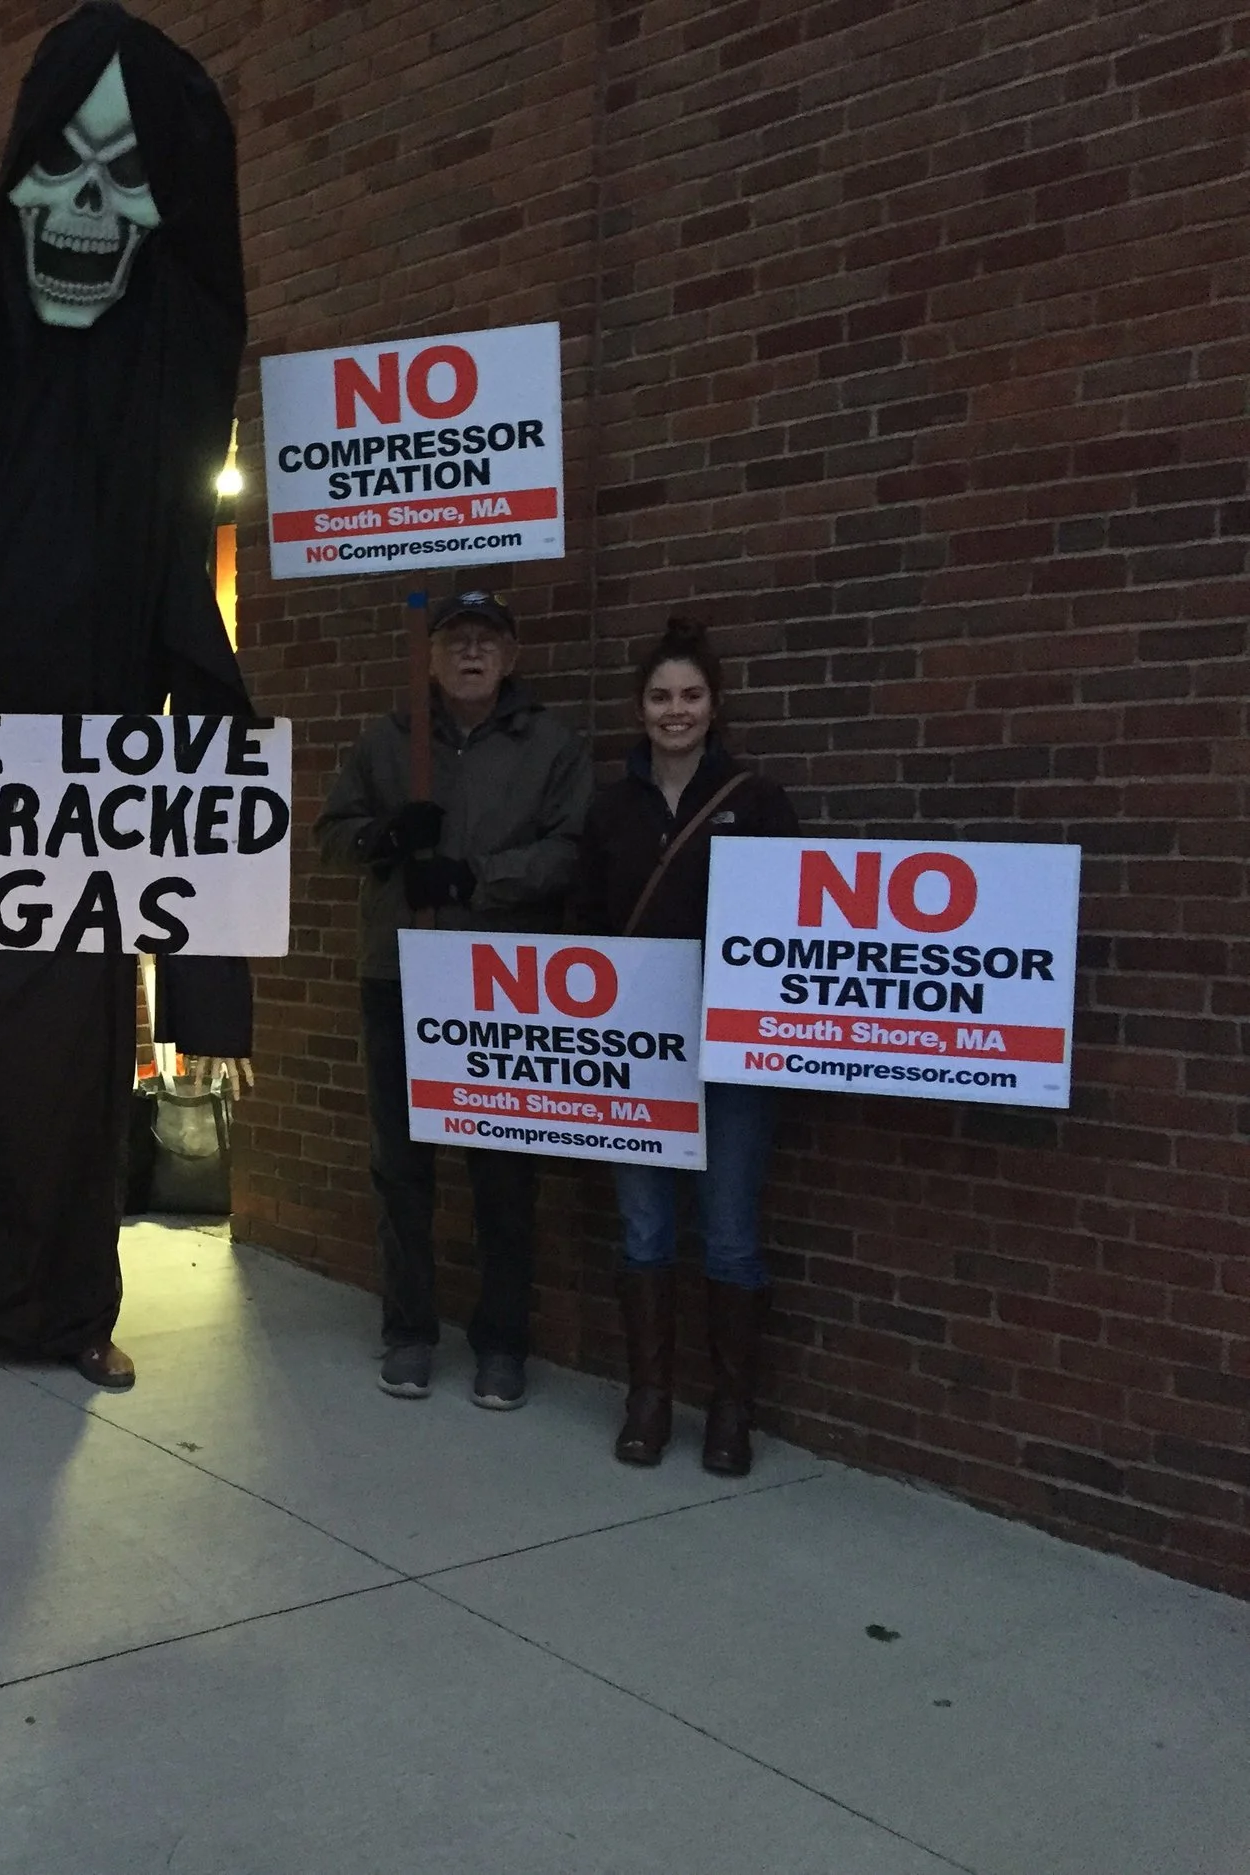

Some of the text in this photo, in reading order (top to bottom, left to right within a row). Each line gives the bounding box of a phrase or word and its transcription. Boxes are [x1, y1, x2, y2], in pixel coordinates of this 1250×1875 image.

[334, 345, 478, 430] NO
[278, 419, 545, 473] COMPRESSOR
[328, 457, 490, 500] STATION
[314, 497, 511, 533] South Shore, MA
[306, 532, 522, 564] NOCompressor.com
[61, 714, 275, 776] LOVE
[797, 850, 977, 934] NO
[721, 935, 1054, 981] COMPRESSOR
[471, 943, 618, 1019] NO
[780, 973, 984, 1015] STATION
[417, 1017, 687, 1062] COMPRESSOR
[758, 1016, 1006, 1053] South Shore, MA
[466, 1051, 630, 1089] STATION
[744, 1051, 1017, 1088] NOCompressor.com
[453, 1087, 652, 1123] South Shore, MA
[444, 1117, 662, 1154] NOCompressor.com
